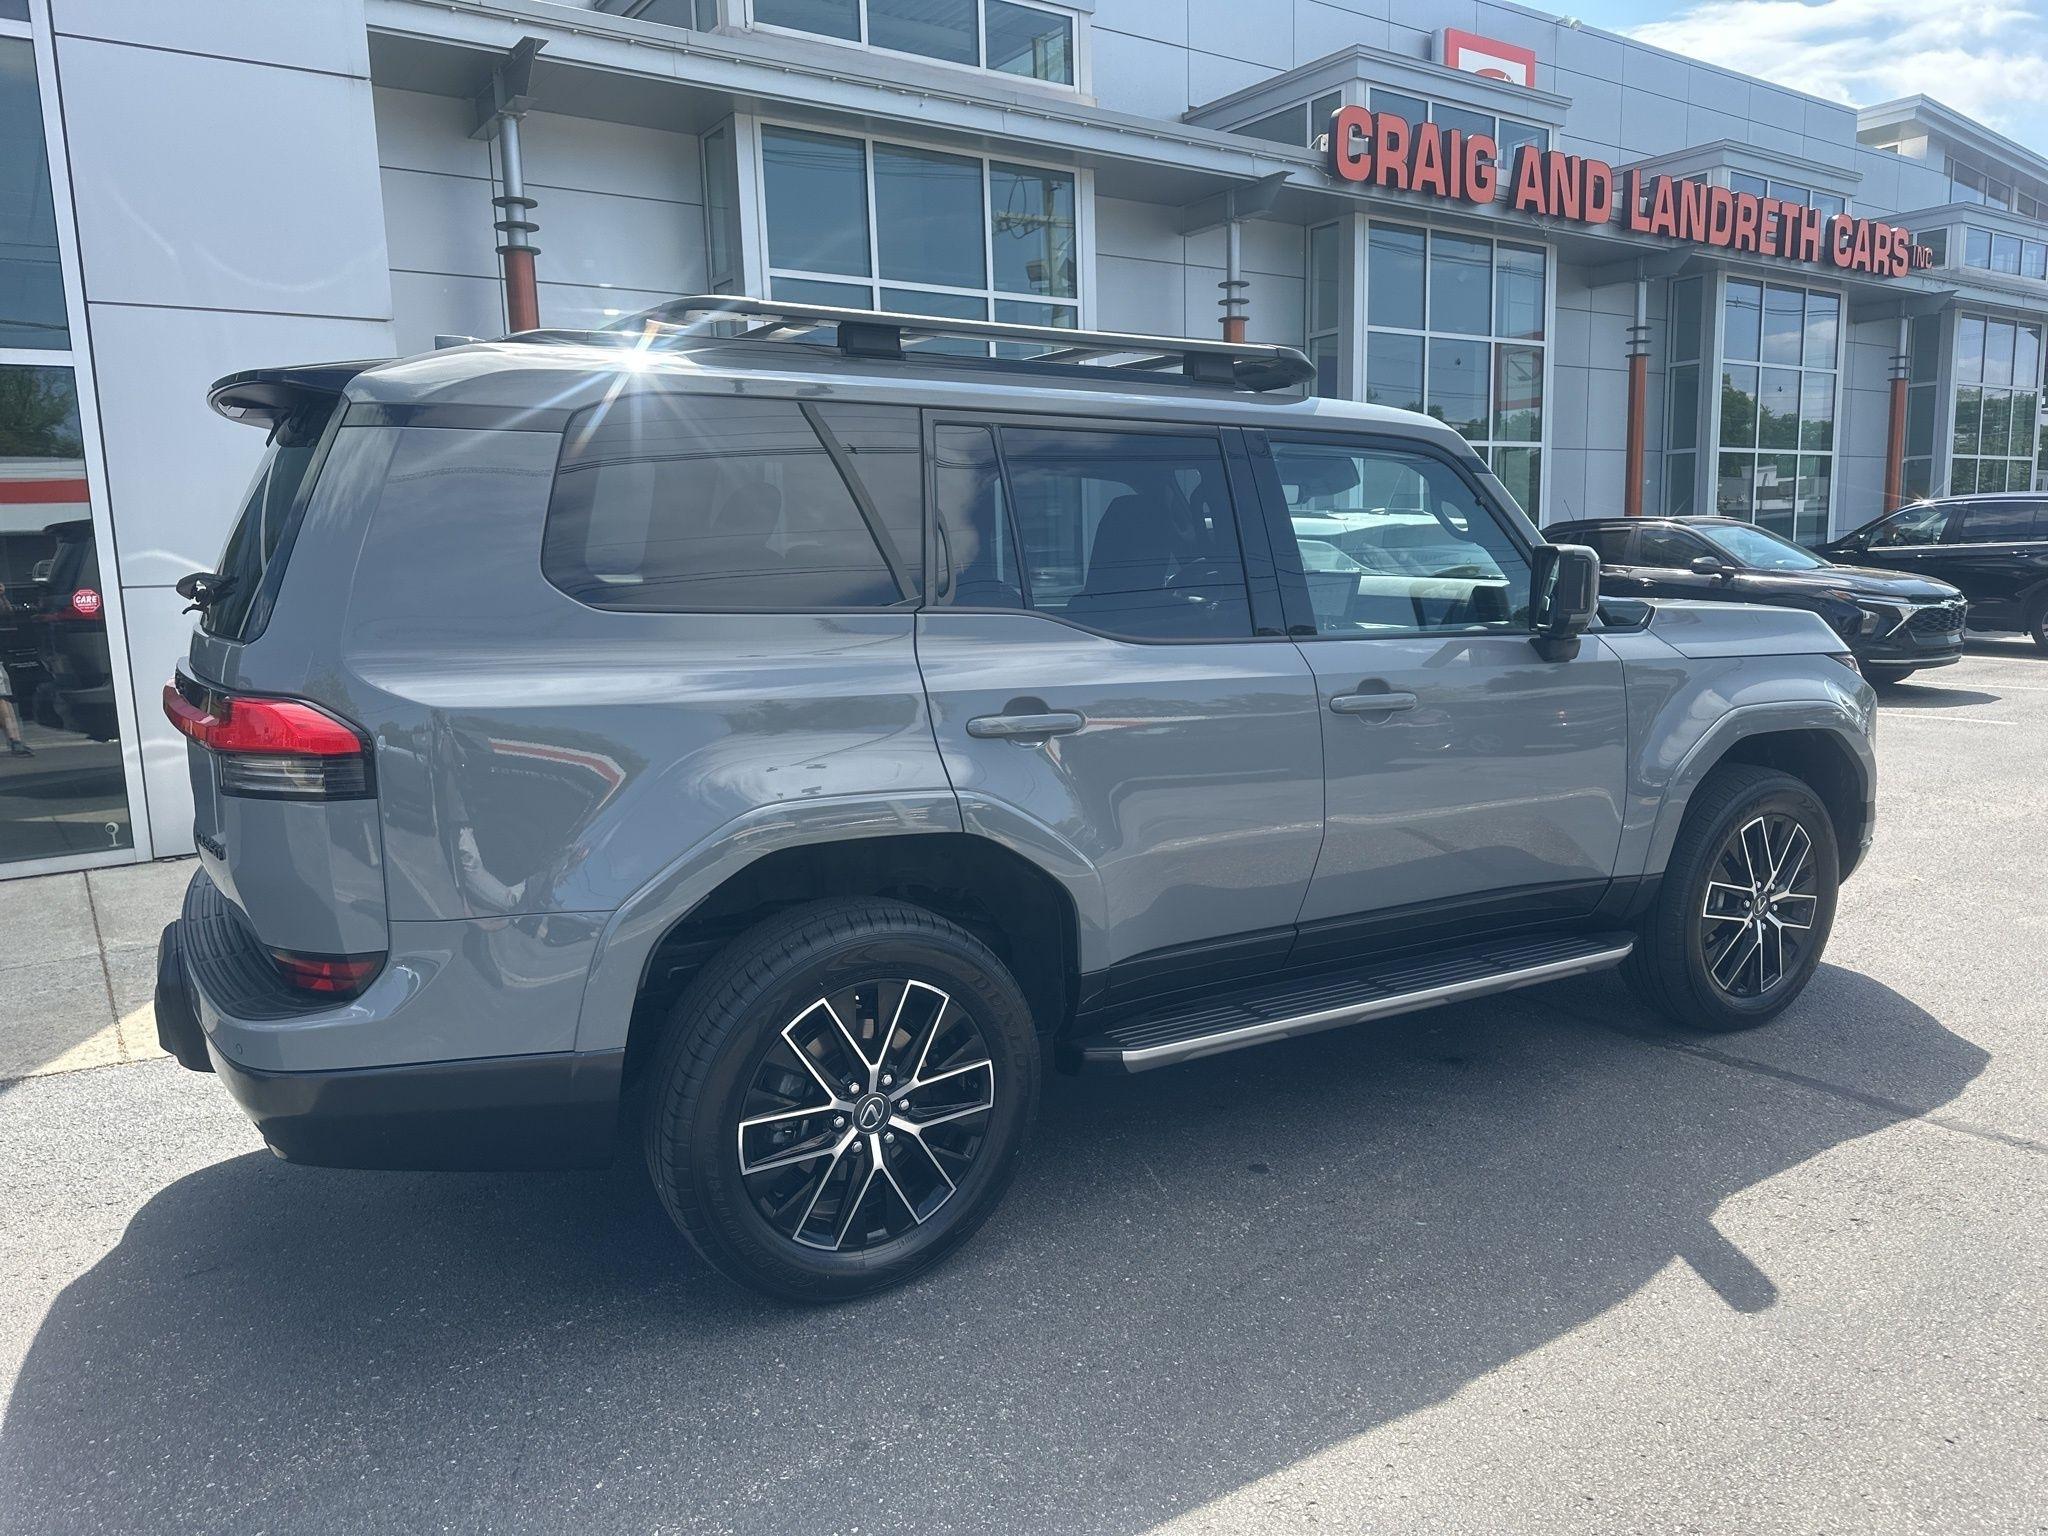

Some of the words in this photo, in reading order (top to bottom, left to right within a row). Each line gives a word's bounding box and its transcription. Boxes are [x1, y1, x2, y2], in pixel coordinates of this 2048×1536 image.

[1331, 104, 1498, 204] CRAIG
[1512, 144, 1618, 224] AND
[1627, 168, 1821, 262] LANDRETH
[1829, 212, 1910, 278] CARS
[1912, 245, 1933, 269] INC
[75, 595, 97, 604] CARE
